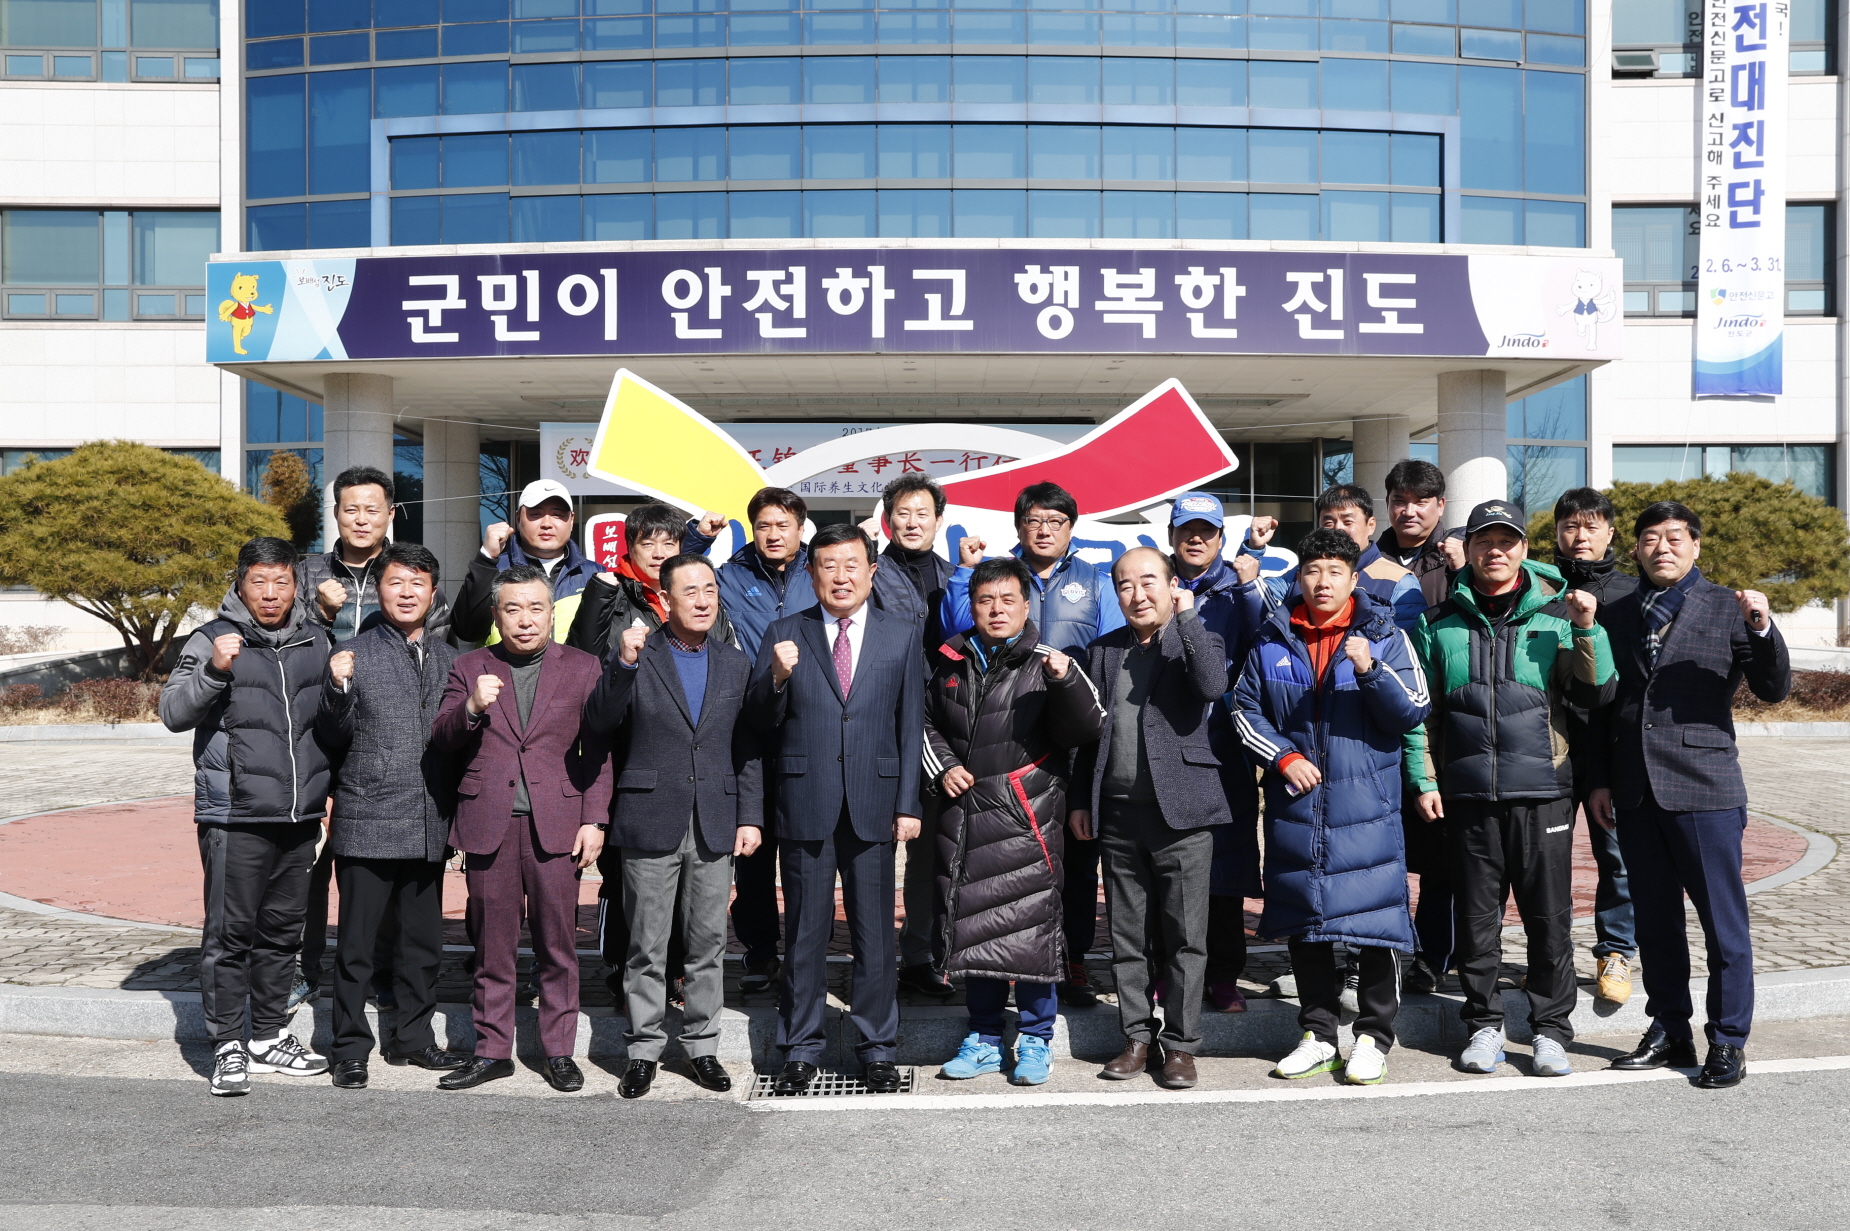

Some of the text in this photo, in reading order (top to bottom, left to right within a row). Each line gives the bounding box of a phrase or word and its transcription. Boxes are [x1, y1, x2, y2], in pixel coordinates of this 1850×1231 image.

[1707, 112, 1724, 165] 신고해
[1728, 3, 1767, 229] 전대진단
[1705, 176, 1722, 227] 주세요
[321, 274, 350, 292] 진도
[402, 264, 1424, 343] 군민이 안전하고 행복한 진도
[1497, 335, 1541, 348] Jindo
[1713, 317, 1759, 329] Jindo
[602, 525, 619, 569] 보배섬
